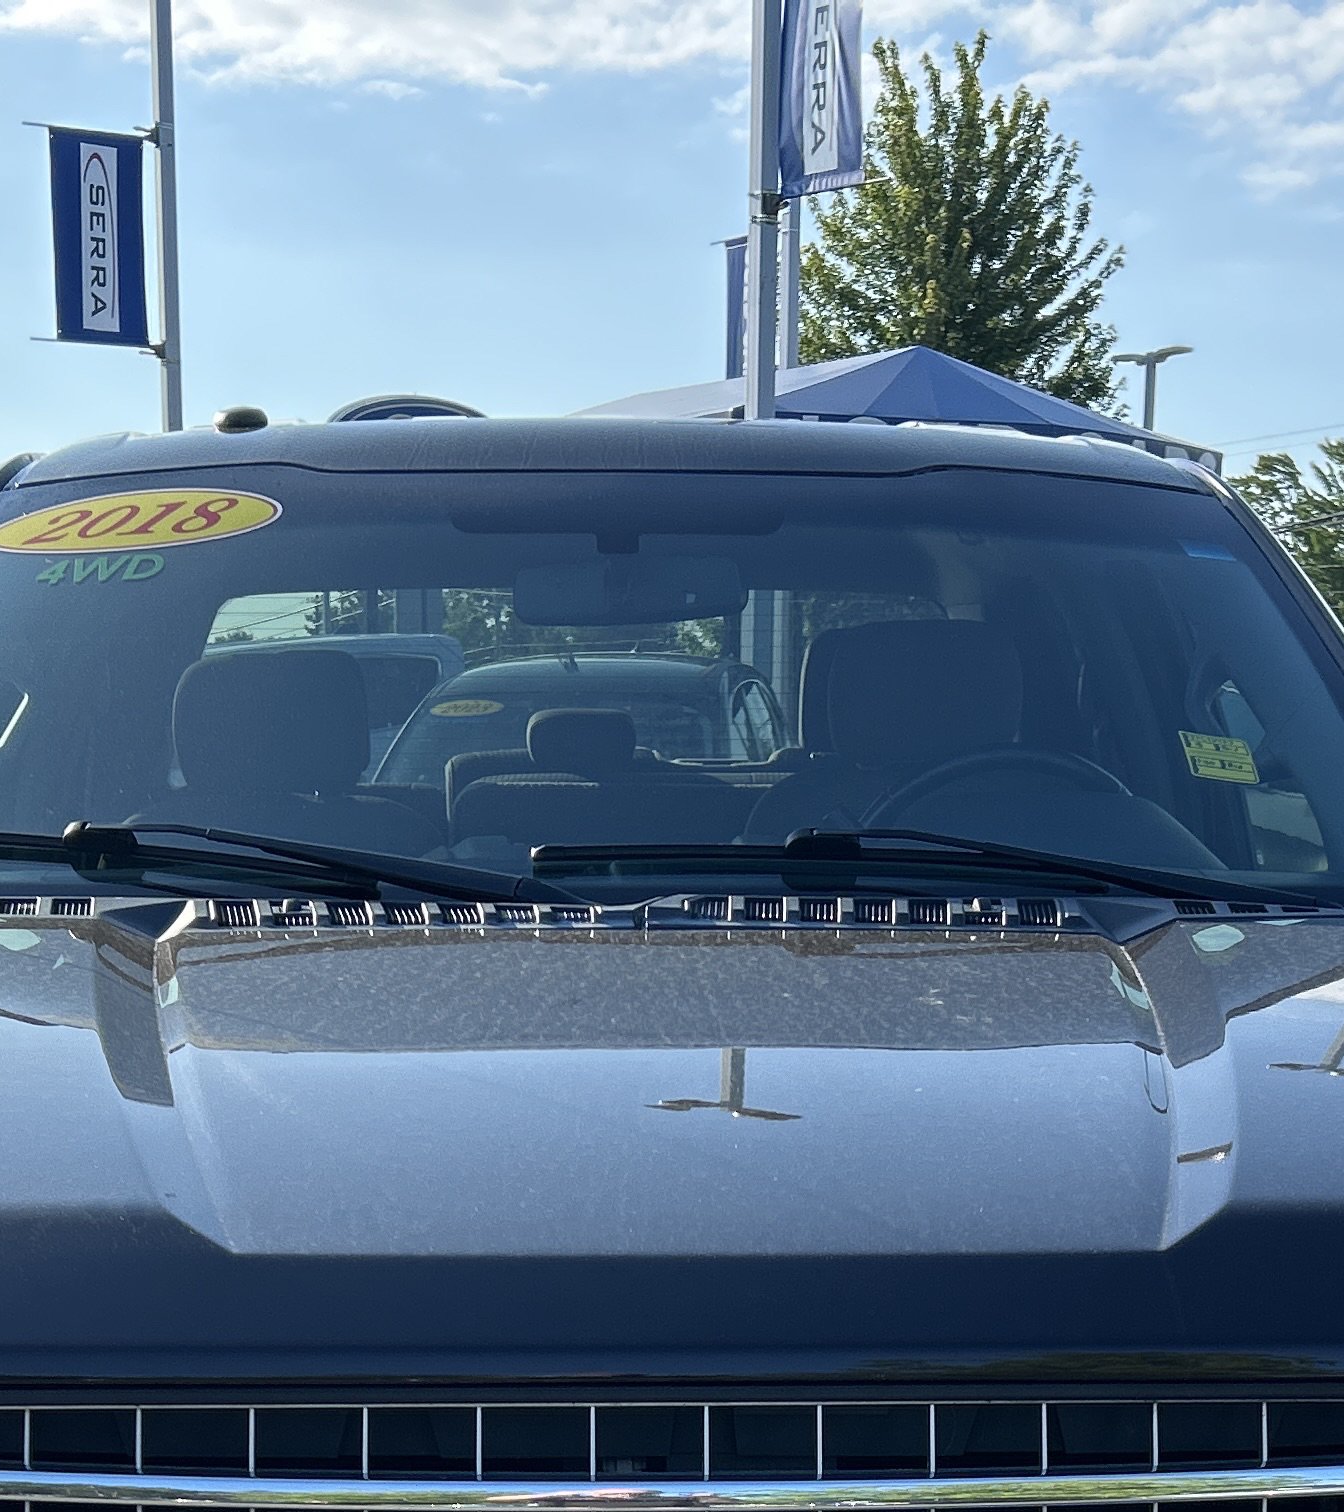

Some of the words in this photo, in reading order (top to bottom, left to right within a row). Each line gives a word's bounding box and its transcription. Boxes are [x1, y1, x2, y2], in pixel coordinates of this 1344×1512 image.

[89, 183, 107, 317] SERRA
[22, 498, 239, 546] 2018
[36, 553, 166, 584] 4WD
